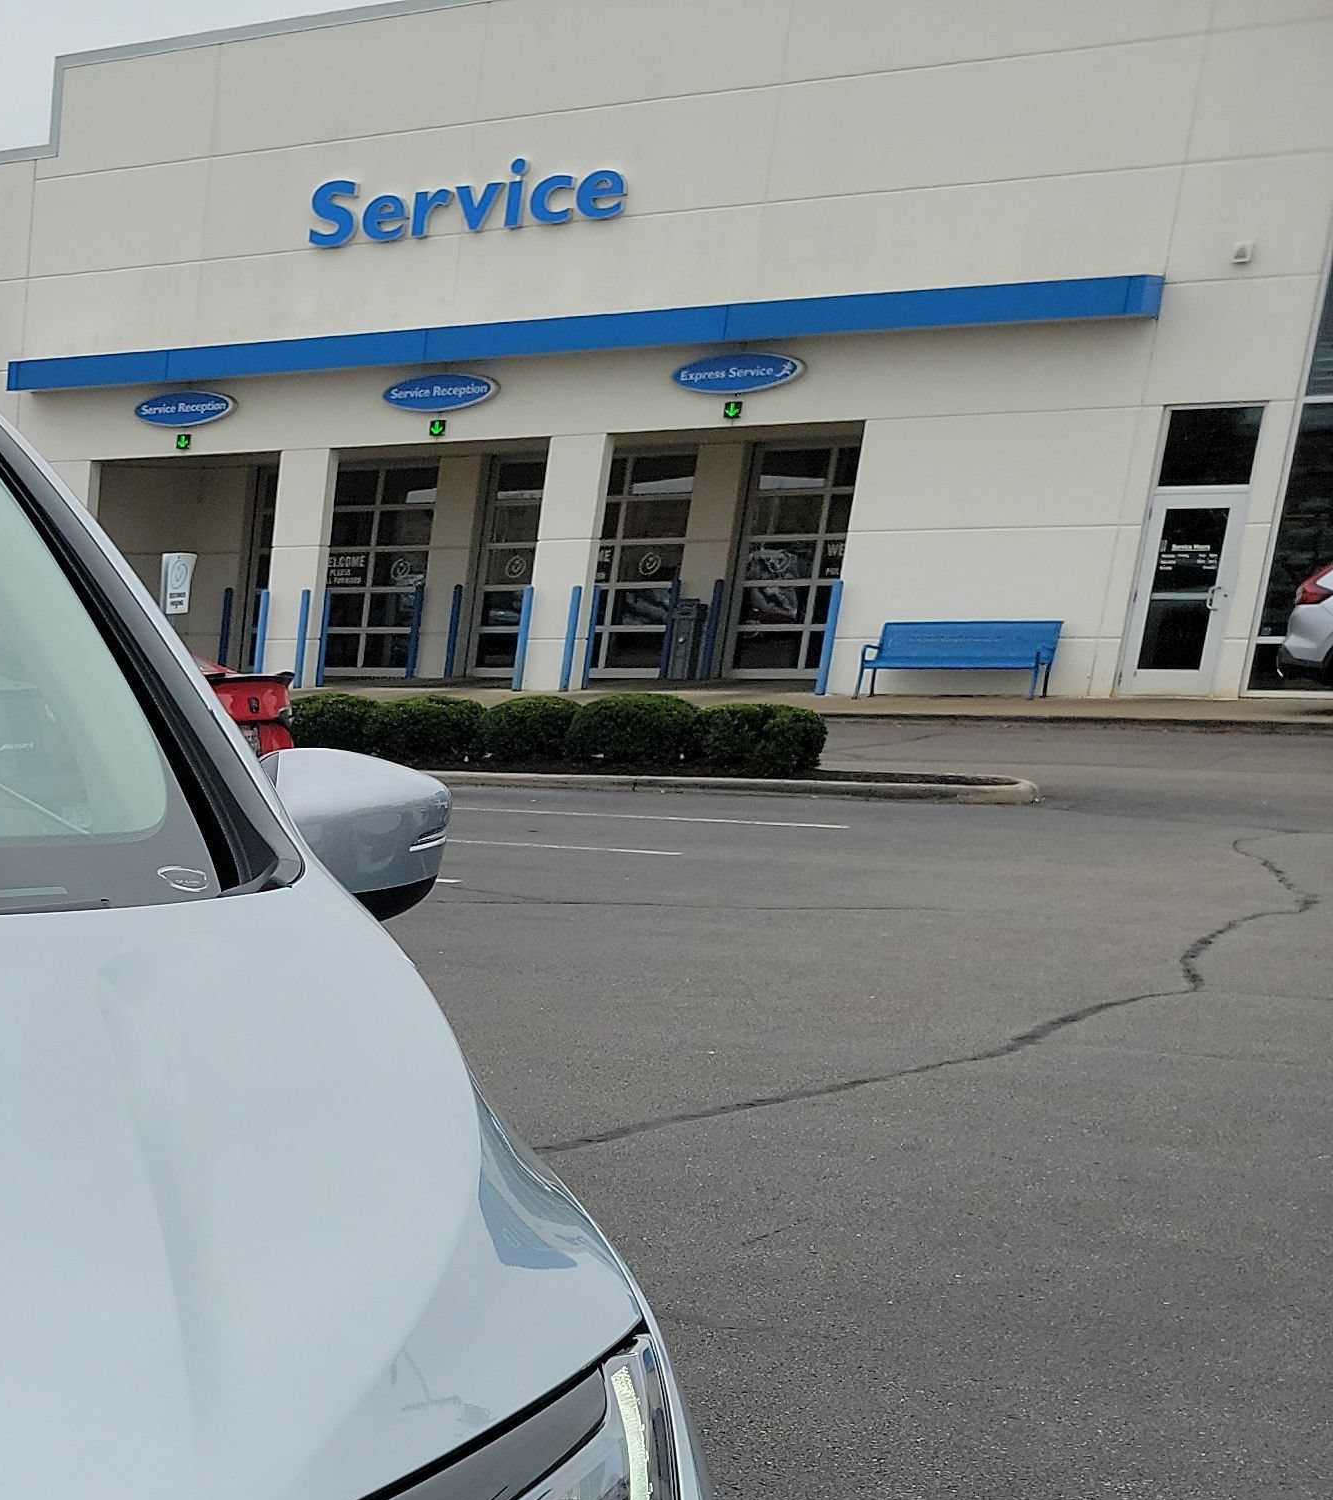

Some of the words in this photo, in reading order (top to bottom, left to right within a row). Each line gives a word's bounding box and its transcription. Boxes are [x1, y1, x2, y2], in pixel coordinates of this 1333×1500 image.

[309, 157, 627, 248] Service
[680, 370, 726, 382] Express
[728, 365, 774, 378] Service
[390, 387, 431, 399] Service
[432, 383, 488, 398] Reception
[140, 403, 176, 415] Service
[177, 401, 227, 414] Reception
[328, 555, 366, 567] ELCOME
